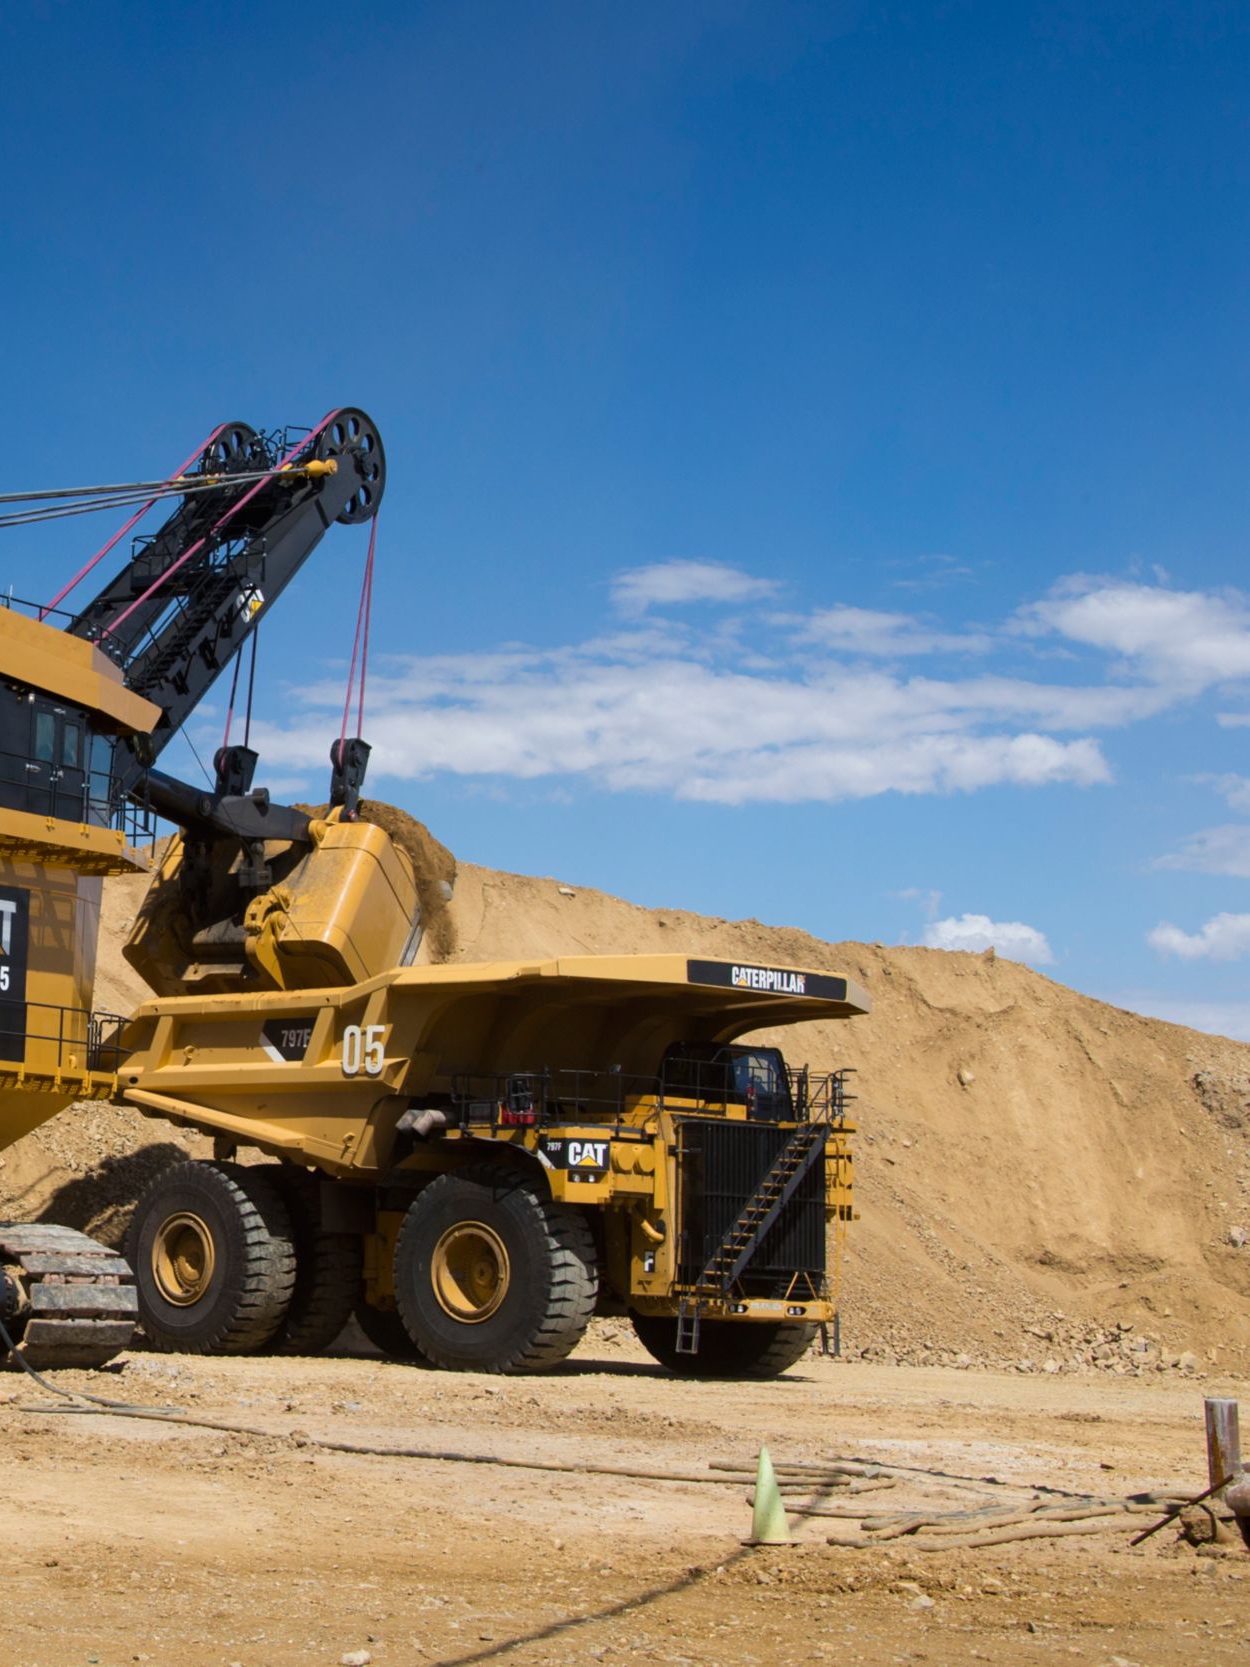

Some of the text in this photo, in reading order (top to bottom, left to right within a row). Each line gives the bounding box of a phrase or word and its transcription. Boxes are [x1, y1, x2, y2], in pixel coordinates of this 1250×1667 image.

[731, 966, 805, 994] CATERPILLAR
[343, 1024, 386, 1075] 05
[546, 1142, 562, 1151] 797F
[568, 1142, 608, 1167] CAT
